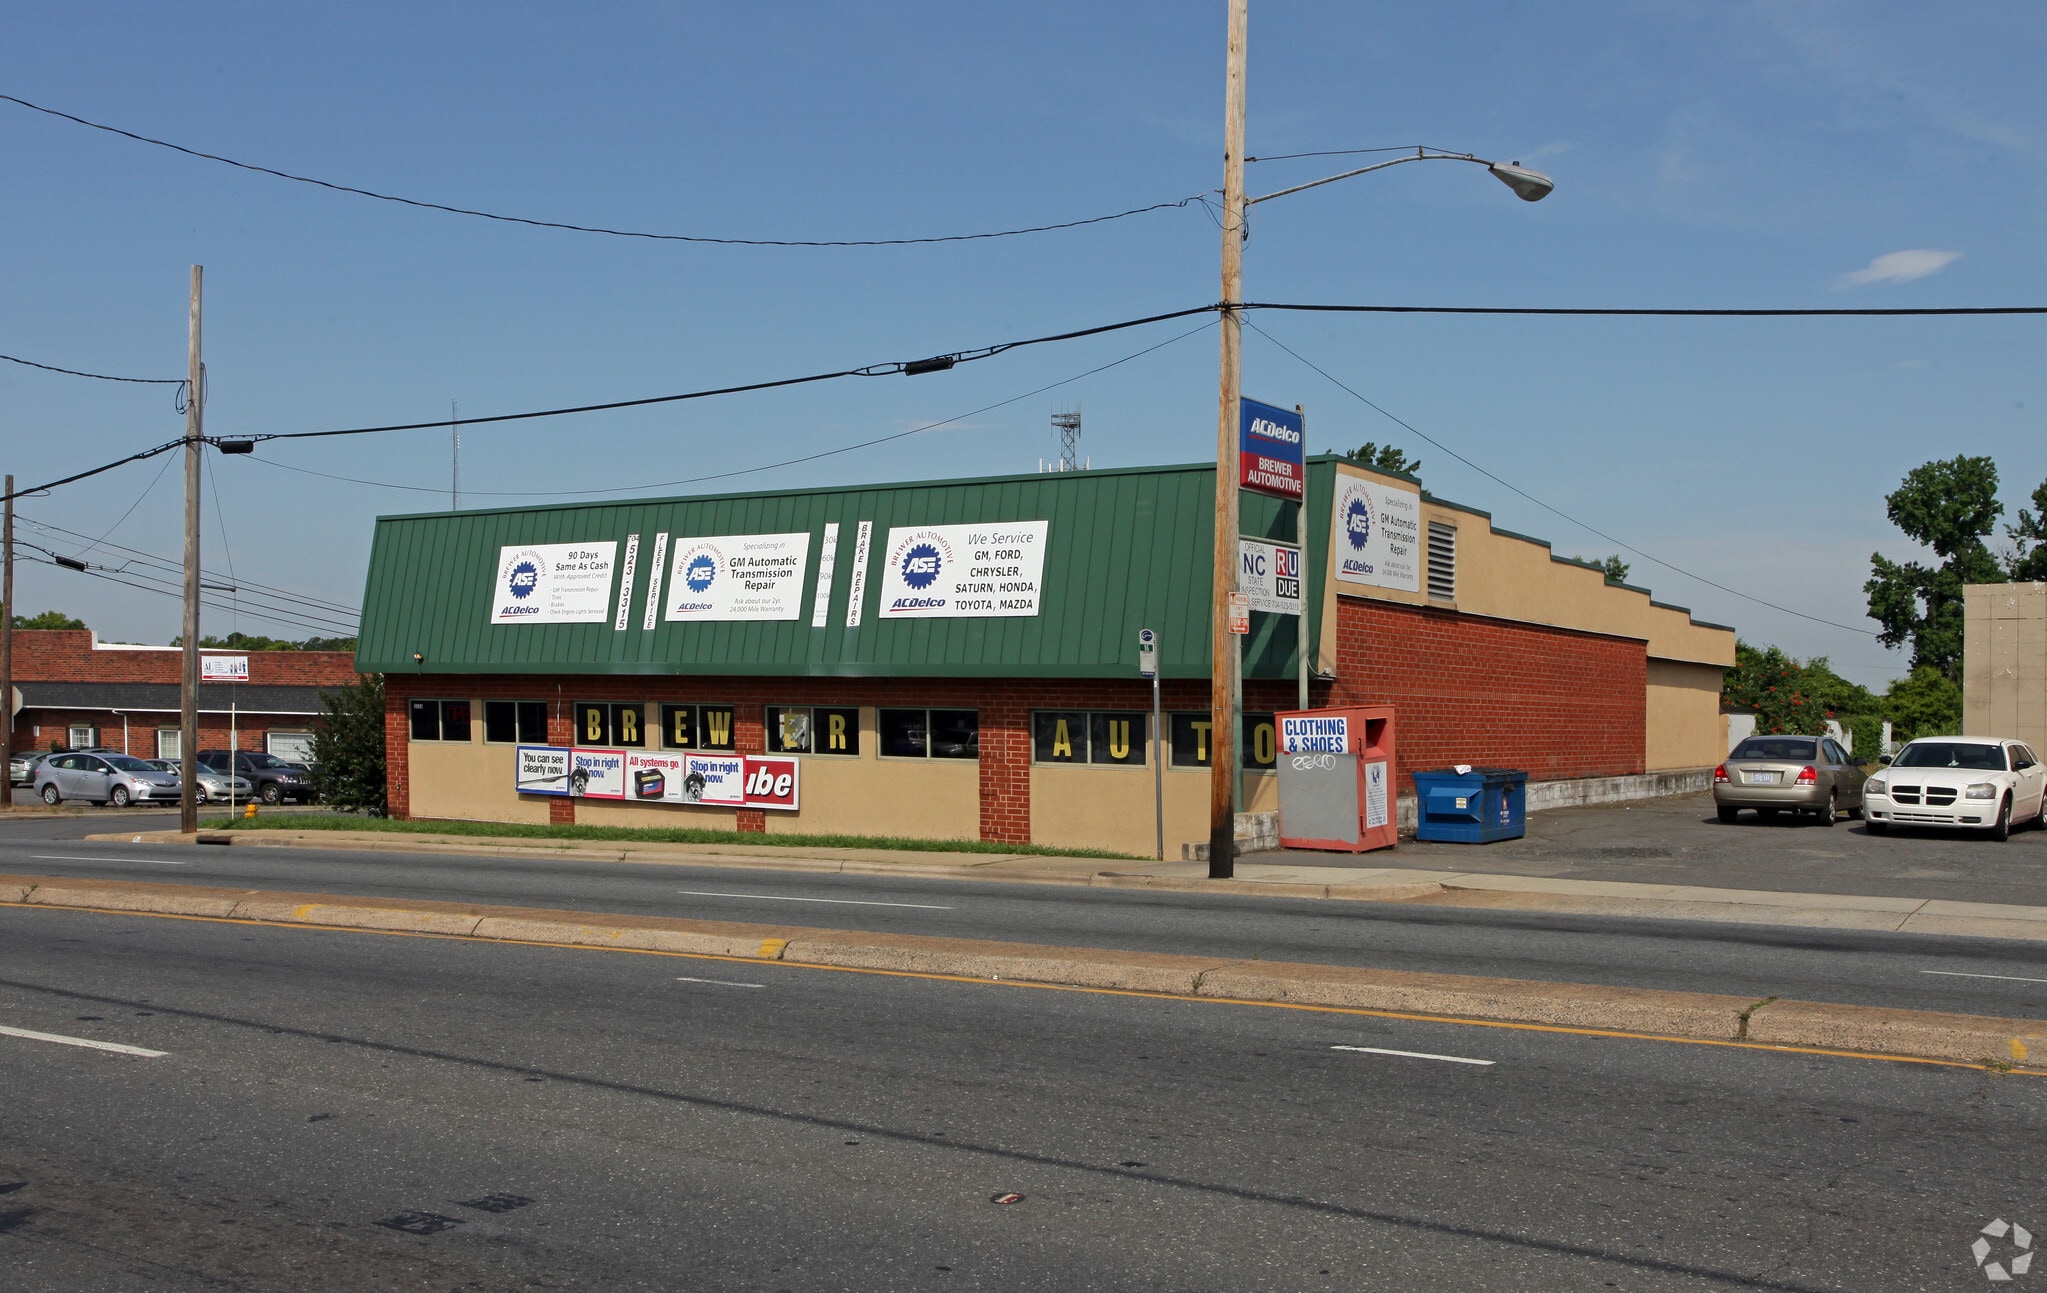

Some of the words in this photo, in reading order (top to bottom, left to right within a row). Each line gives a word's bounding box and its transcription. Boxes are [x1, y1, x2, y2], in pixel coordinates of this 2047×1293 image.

[1250, 417, 1300, 444] ACDelco
[1259, 457, 1292, 476] BREWER
[1247, 469, 1302, 493] AUTOMOTIVE
[1385, 496, 1408, 512] Specializing
[1349, 513, 1367, 533] ASE
[1380, 513, 1389, 524] GM
[1390, 515, 1416, 531] Automatic
[825, 536, 838, 544] 30k
[968, 533, 988, 545] We
[991, 531, 1034, 544] Service
[1381, 527, 1416, 544] Transmission
[743, 542, 777, 552] Specializing
[778, 541, 785, 549] in
[858, 524, 868, 563] BRAKE
[891, 535, 914, 567] BREWER
[915, 531, 954, 564] AUTOMOTIVE
[1245, 542, 1266, 554] OFFICIAL
[1390, 543, 1407, 557] Repair
[568, 551, 578, 560] 90
[580, 550, 599, 561] Days
[656, 535, 665, 570] FLEET
[677, 547, 696, 575] BREWER
[697, 542, 725, 573] AUTOMOTIVE
[974, 551, 992, 561] GM,
[994, 550, 1024, 561] FORD,
[502, 553, 519, 579] BREWER
[521, 549, 547, 577] AUTOMOTIVE
[555, 563, 576, 571] Same
[578, 562, 588, 570] As
[590, 561, 608, 570] Cash
[729, 557, 746, 567] GM
[748, 555, 797, 567] Automatic
[905, 557, 936, 573] ASE
[1243, 553, 1266, 576] NC
[1343, 559, 1373, 574] ACDelco
[511, 572, 534, 586] ASE
[688, 566, 712, 581] ASE
[731, 568, 793, 579] Transmission
[970, 566, 1023, 578] CHRYSLER,
[744, 580, 775, 592] Repair
[1247, 576, 1264, 586] STATE
[1278, 579, 1298, 597] DUE
[955, 583, 996, 595] SATURN,
[999, 582, 1038, 593] HONDA,
[647, 578, 659, 629] SERVICE
[850, 571, 862, 626] REPAIRS
[892, 598, 946, 608] ACDelco
[955, 600, 996, 612] TOYOTA,
[999, 599, 1033, 610] MAZDA
[501, 606, 539, 614] ACDelco
[678, 602, 713, 610] ACDelco
[760, 605, 785, 613] Warranty
[1285, 718, 1345, 736] CLOTHING
[1289, 737, 1298, 752] &
[1302, 737, 1343, 753] SHOES
[523, 752, 536, 763] You
[537, 755, 550, 764] can
[551, 755, 564, 764] see
[575, 755, 592, 768] Stop
[593, 757, 600, 767] in
[601, 757, 619, 770] right
[629, 756, 638, 766] All
[640, 758, 669, 768] systems
[523, 763, 546, 775] clearly
[690, 760, 708, 773] Stop
[710, 761, 717, 772] in
[719, 761, 739, 775] right
